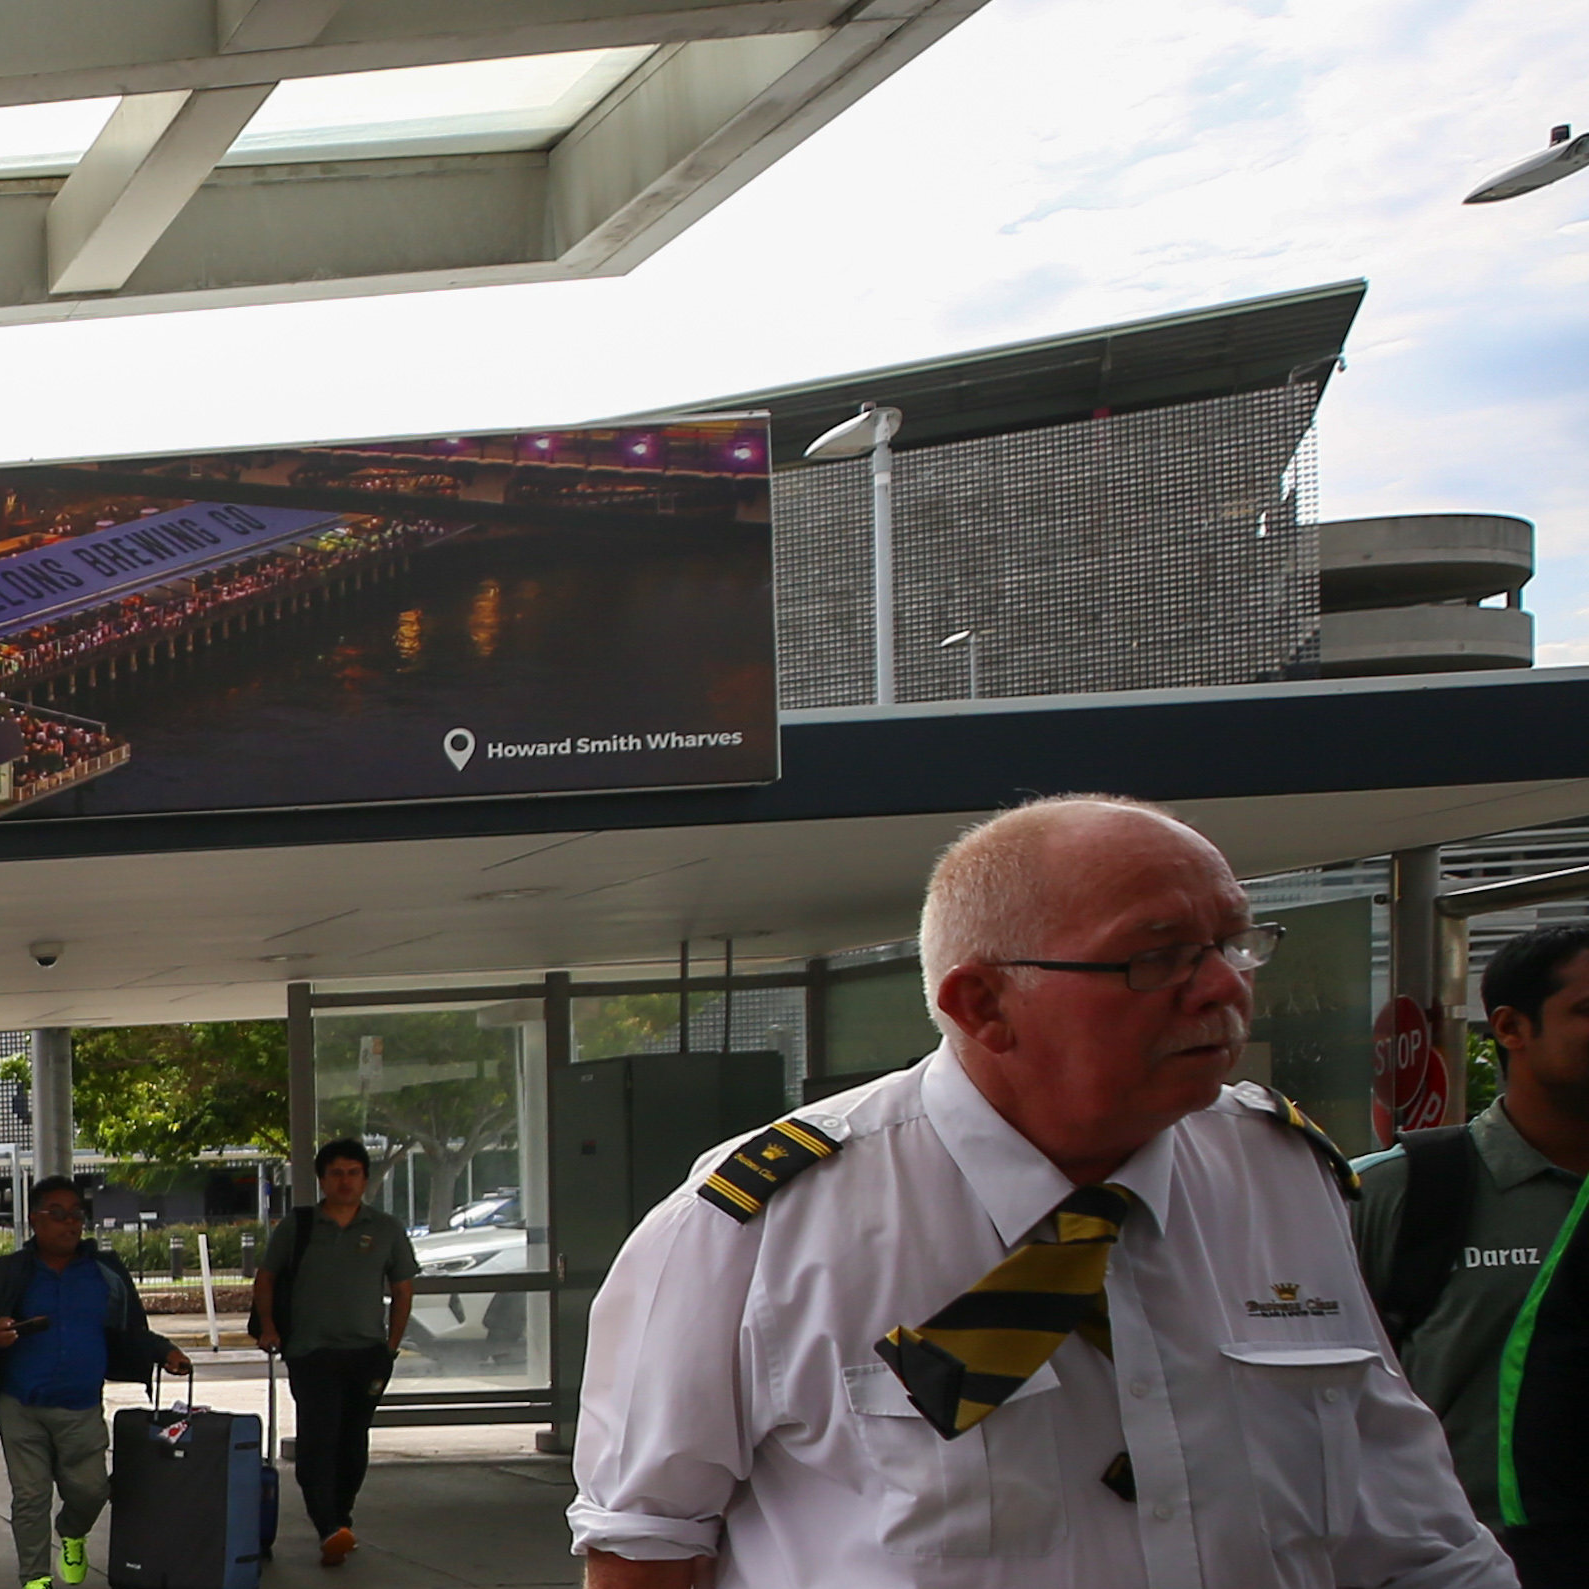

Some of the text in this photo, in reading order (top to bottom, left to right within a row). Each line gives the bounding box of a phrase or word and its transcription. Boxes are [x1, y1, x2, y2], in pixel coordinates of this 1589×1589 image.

[72, 516, 221, 578] BREWING
[486, 727, 743, 760] Howard Smith Wharves
[1374, 1029, 1422, 1076] STOP
[1464, 1247, 1540, 1268] Daraz
